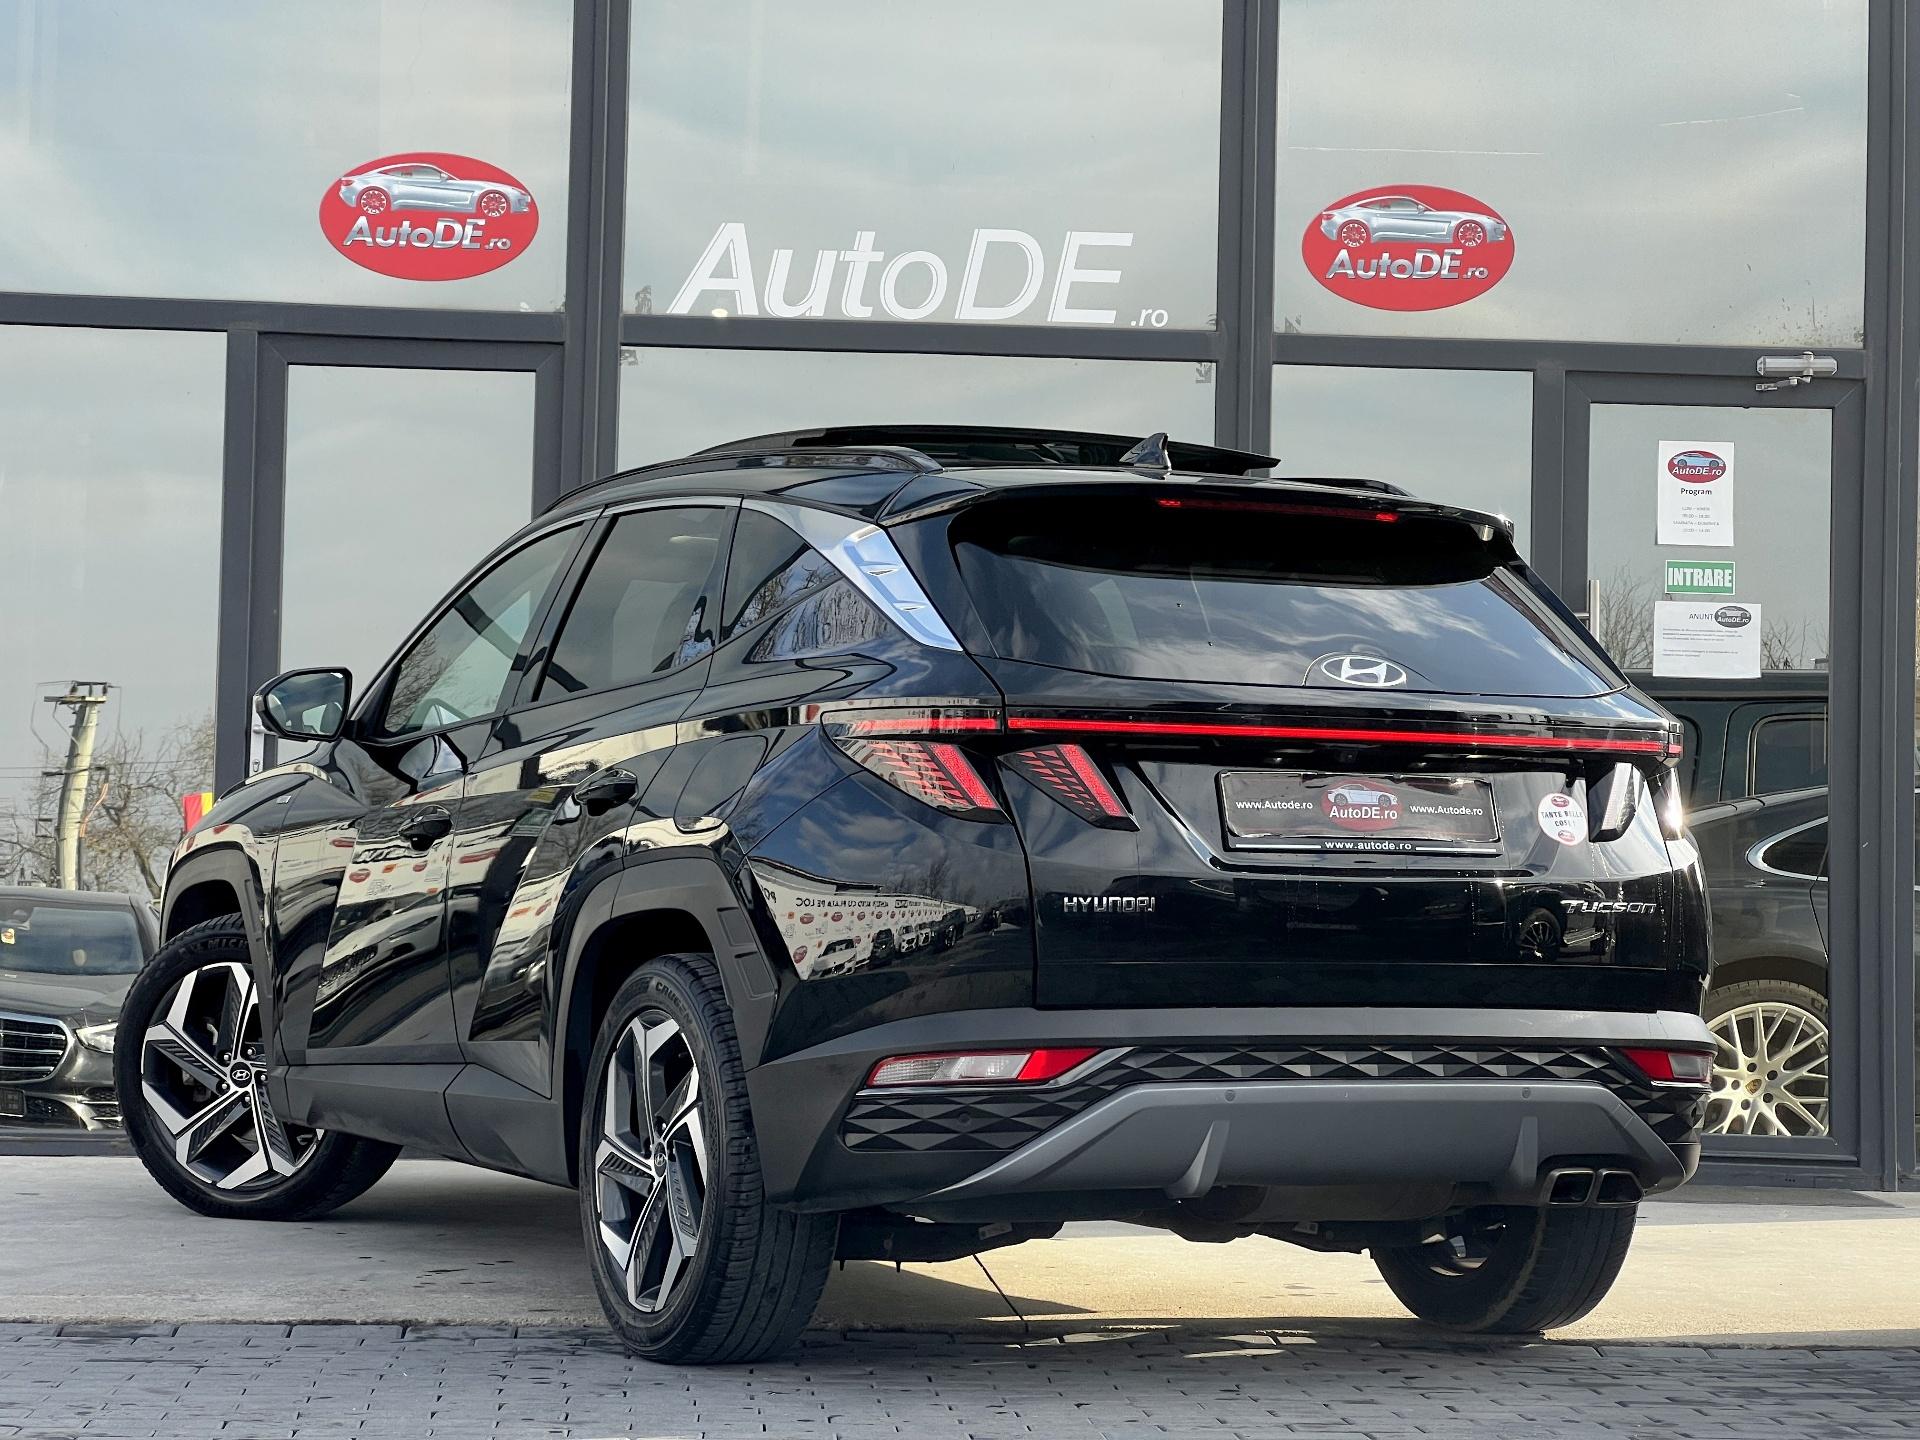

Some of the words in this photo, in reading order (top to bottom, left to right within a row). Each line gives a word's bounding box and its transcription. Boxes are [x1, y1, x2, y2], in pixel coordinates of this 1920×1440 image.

[1671, 466, 1723, 476] AutoDE.ro
[1680, 487, 1713, 496] Program
[1667, 567, 1732, 588] INTRARE
[1235, 800, 1314, 811] www.Autode.ro
[1410, 804, 1484, 816] www.Autode.ro
[1329, 805, 1398, 820] AutoDE.ro
[1325, 840, 1412, 851] www.autode.ro
[1063, 896, 1155, 913] HYUNDAI
